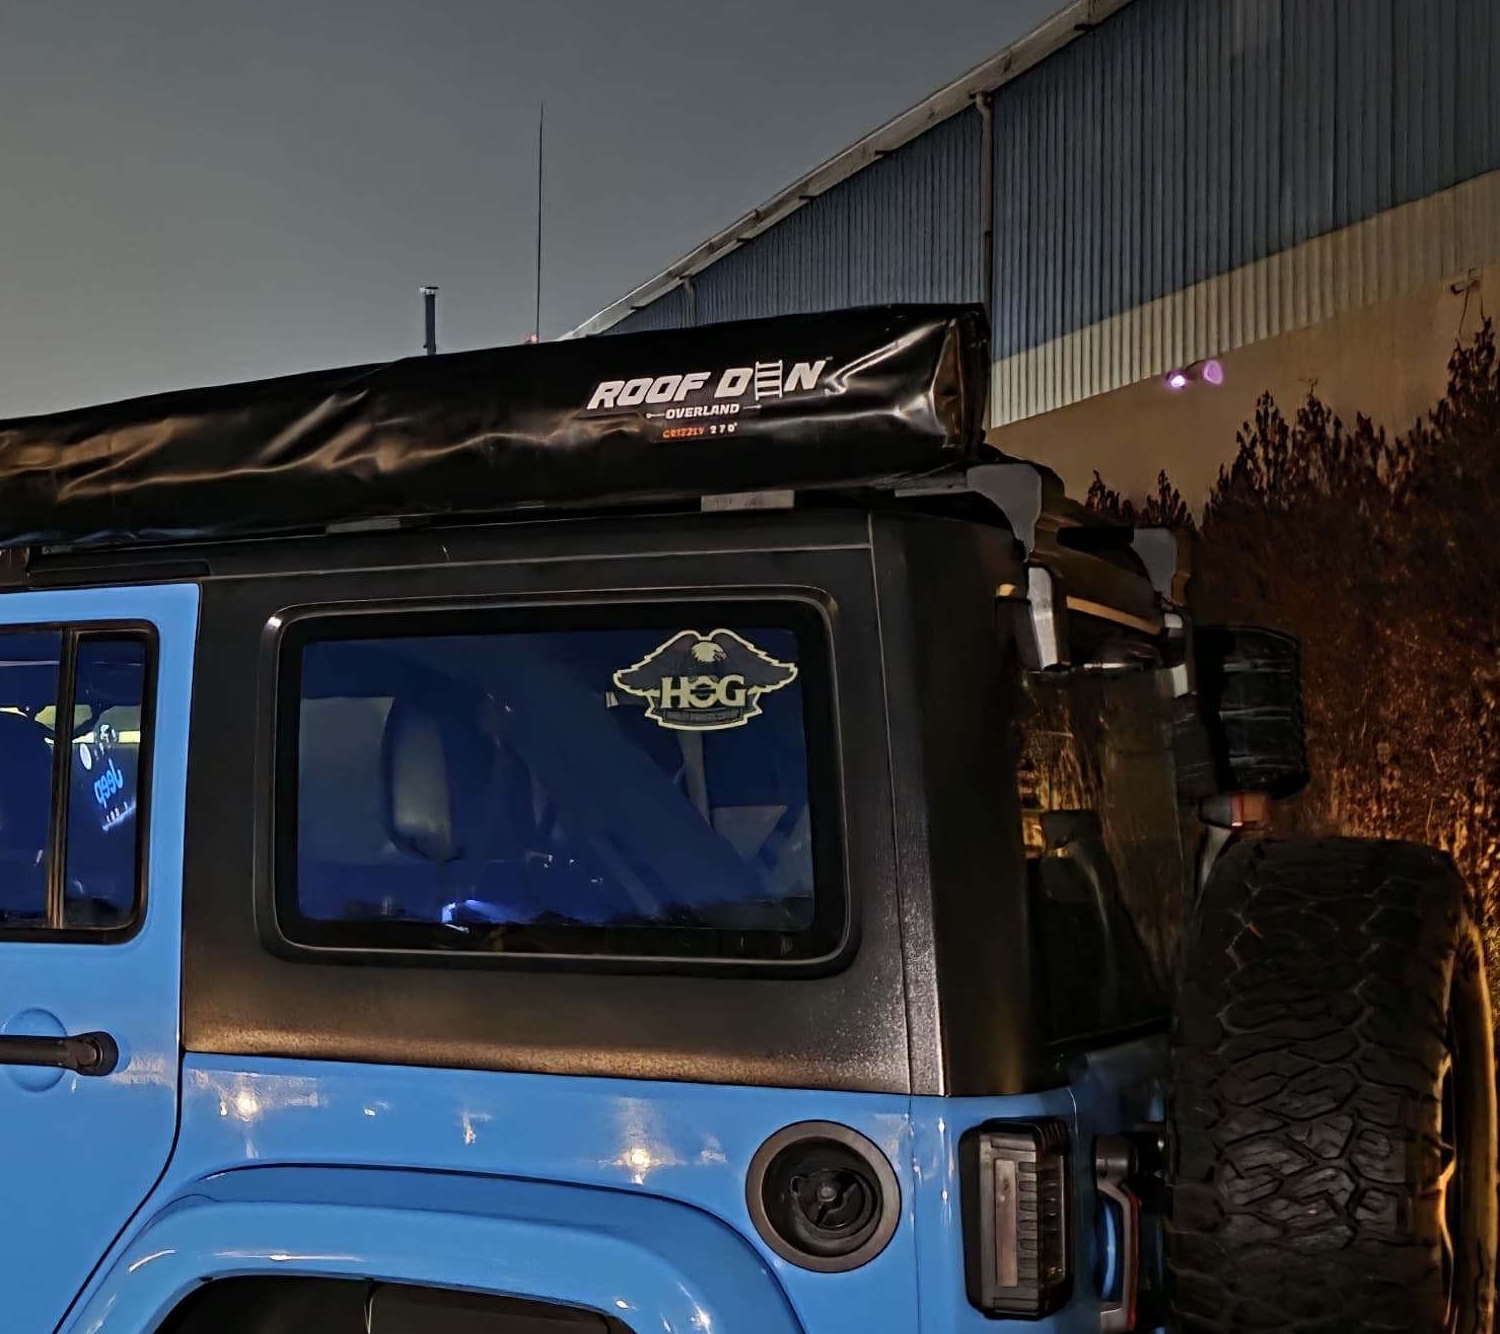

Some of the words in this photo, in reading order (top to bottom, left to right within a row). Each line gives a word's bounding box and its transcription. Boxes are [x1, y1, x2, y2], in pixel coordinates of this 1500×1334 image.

[586, 371, 711, 410] ROOF
[665, 403, 740, 420] OVERLAND
[660, 674, 747, 708] HOG
